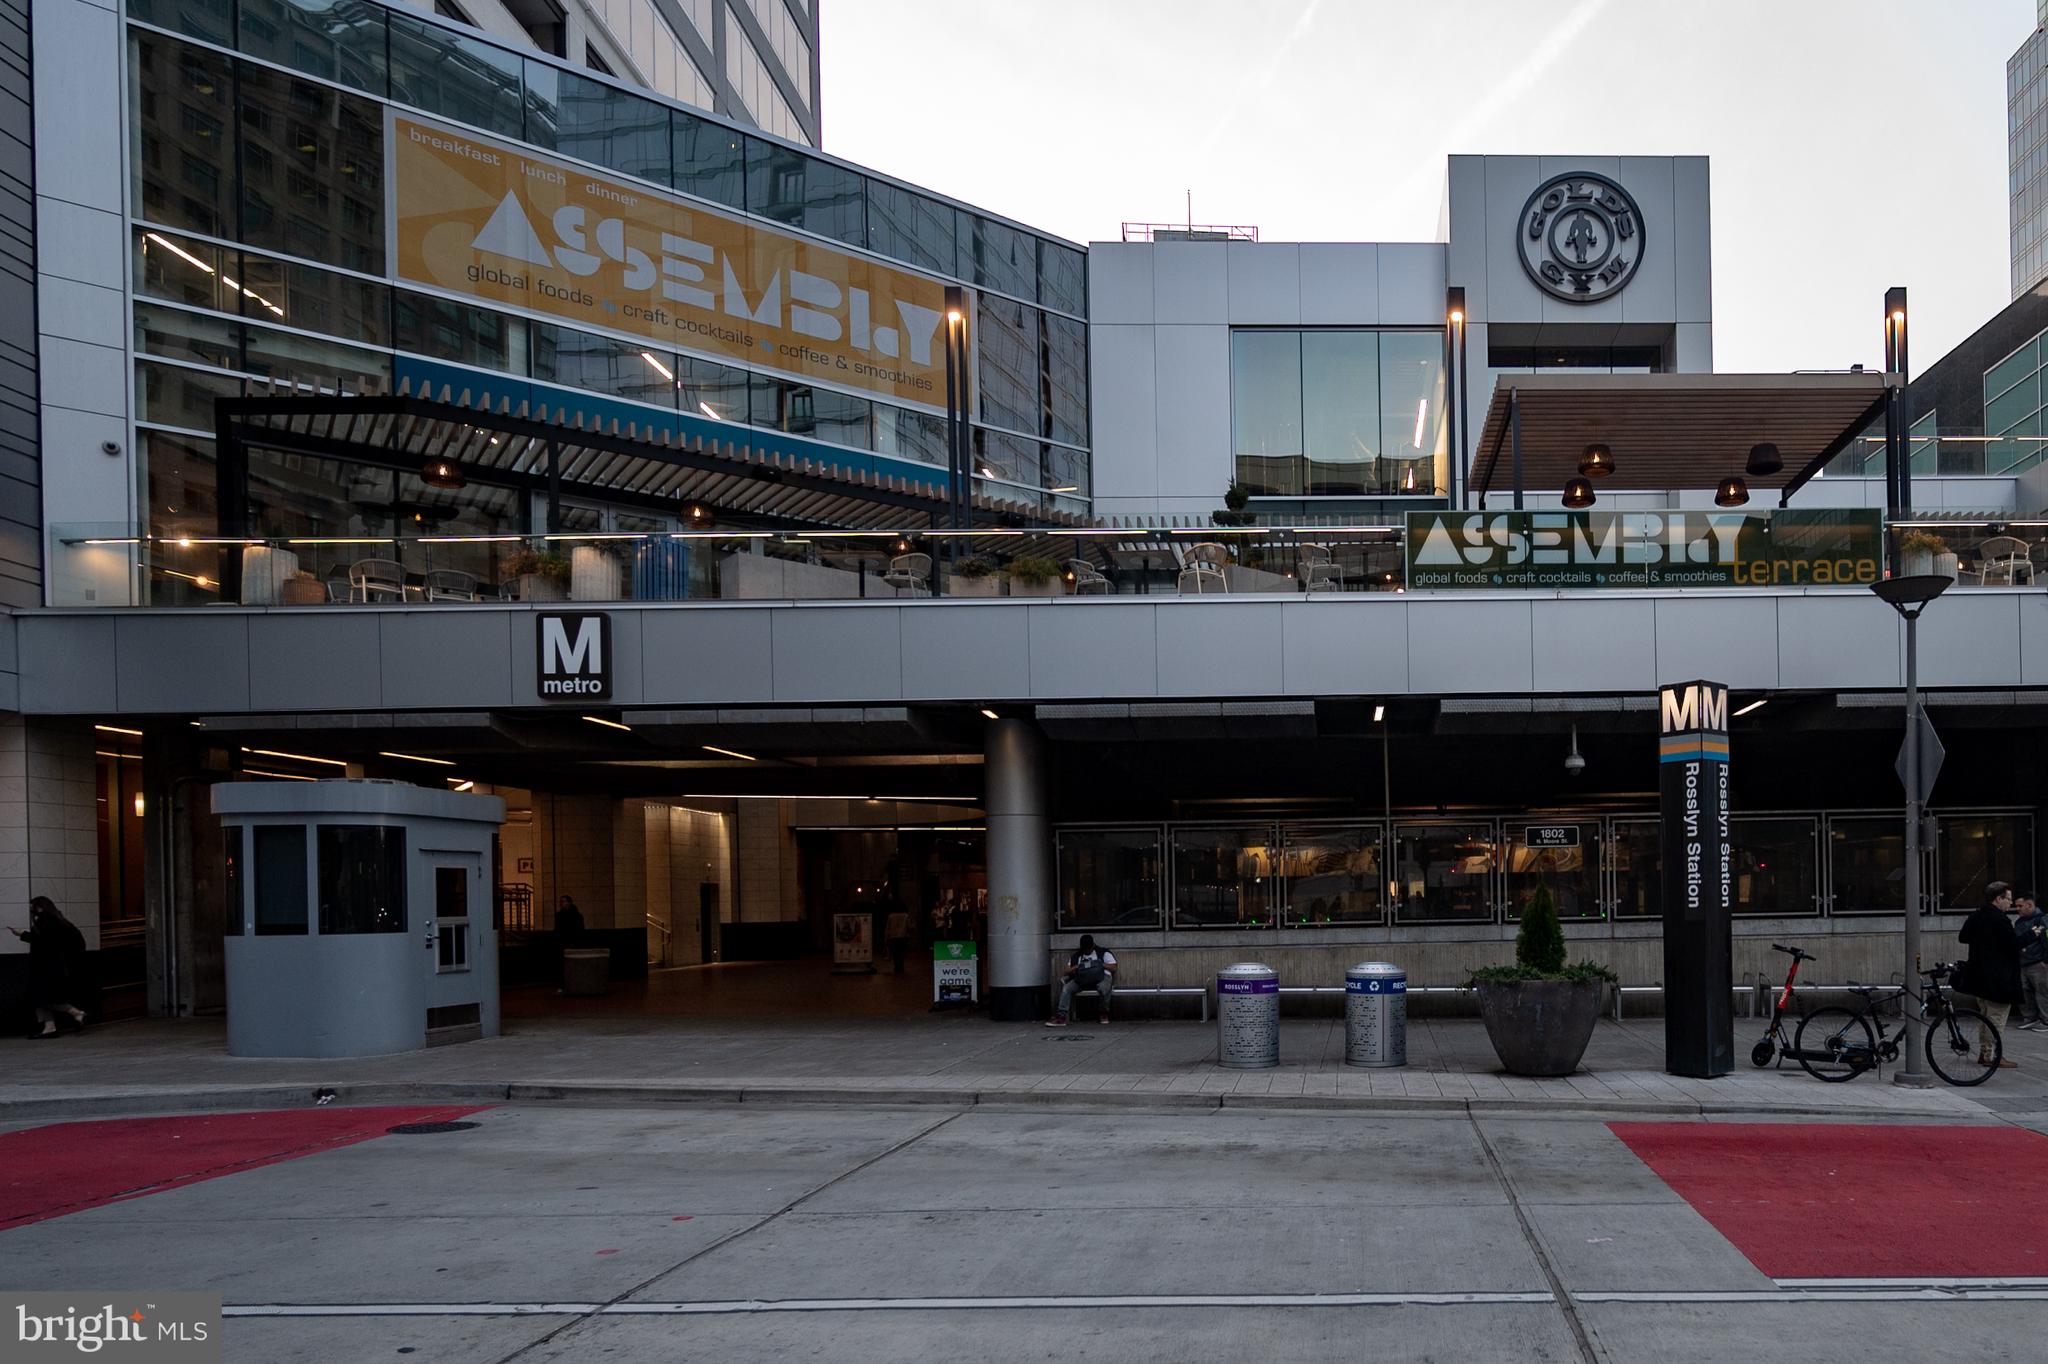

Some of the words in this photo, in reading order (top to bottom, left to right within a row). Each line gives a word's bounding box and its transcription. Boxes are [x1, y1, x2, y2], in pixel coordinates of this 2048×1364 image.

[409, 127, 501, 166] breakfast
[519, 160, 567, 186] lunch
[585, 182, 638, 207] dinner
[470, 188, 944, 367] ASSEMBLY
[1540, 253, 1630, 294] GYM
[466, 263, 529, 292] global
[537, 279, 594, 307] foods
[622, 303, 669, 326] craft
[674, 316, 754, 347] cocktails
[779, 343, 830, 366] coffee
[835, 354, 849, 370] &
[854, 361, 933, 392] smoothies
[1414, 514, 1748, 565] ASSEMBLY
[1717, 536, 1877, 585] terrace
[1415, 571, 1451, 586] global
[1455, 571, 1489, 584] foods
[1506, 571, 1537, 584] craft
[1539, 570, 1592, 583] cocktails
[1608, 570, 1647, 583] coffee
[1650, 570, 1661, 582] &
[1664, 570, 1727, 582] smoothies
[543, 617, 602, 674] M
[543, 677, 603, 694] metro
[1661, 685, 1700, 733] M
[1702, 686, 1728, 732] M
[1684, 761, 1700, 838] Rosslyn
[1717, 763, 1729, 838] Rosslyn
[1541, 829, 1565, 839] 1802
[1686, 842, 1702, 909] Station
[1720, 842, 1731, 908] Station
[942, 966, 971, 976] we're
[1224, 983, 1250, 991] ROSSLYN
